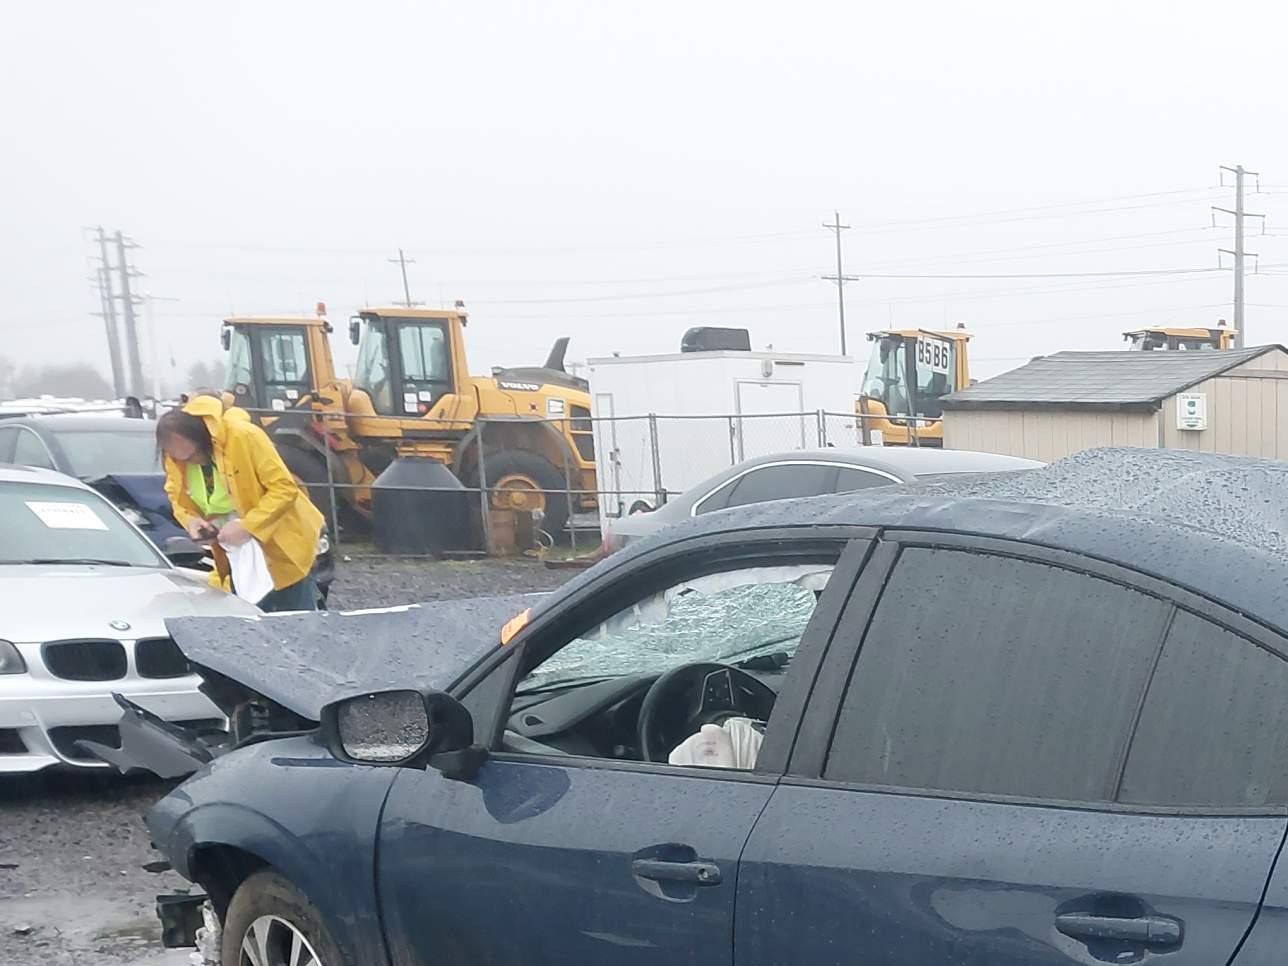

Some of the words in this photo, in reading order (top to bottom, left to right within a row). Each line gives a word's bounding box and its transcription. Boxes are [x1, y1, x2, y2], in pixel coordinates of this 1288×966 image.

[918, 339, 931, 365] B5
[933, 344, 948, 369] B6
[500, 381, 540, 391] VOLVO
